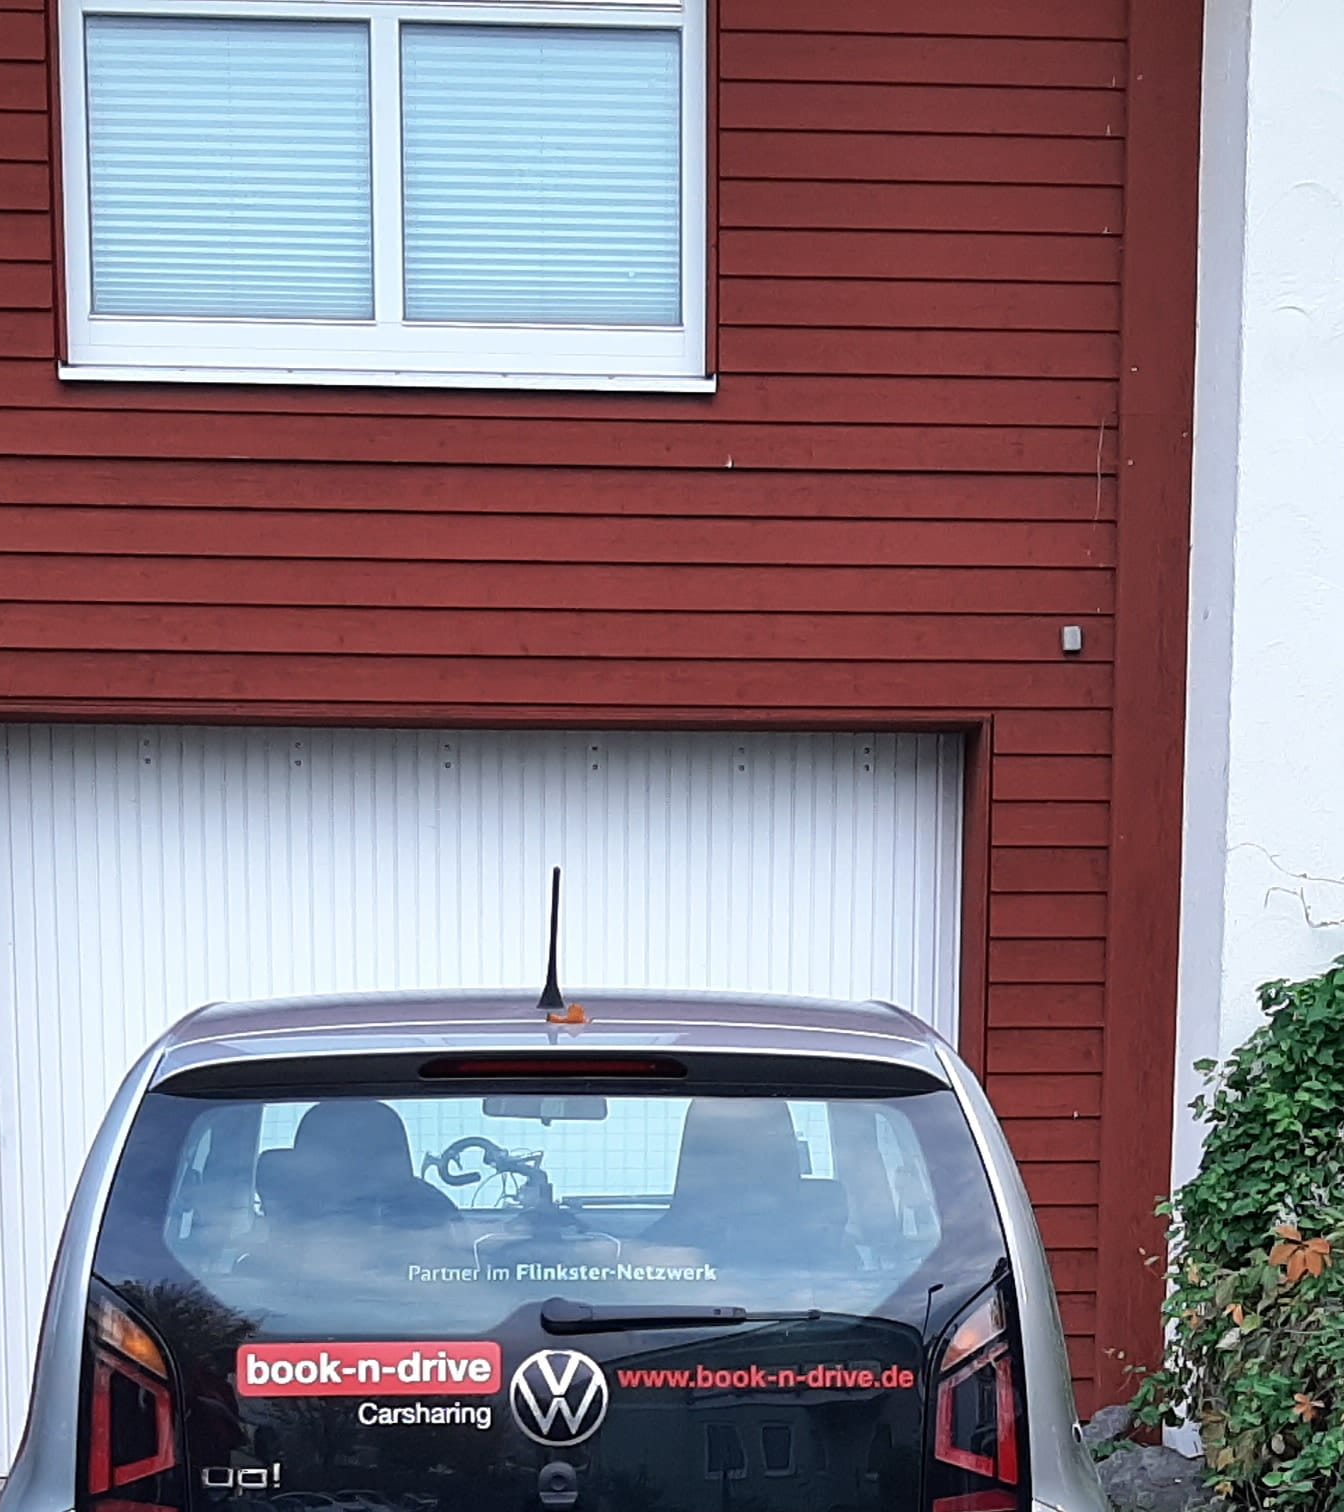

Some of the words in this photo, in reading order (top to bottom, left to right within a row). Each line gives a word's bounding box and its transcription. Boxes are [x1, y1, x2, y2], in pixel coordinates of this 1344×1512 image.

[408, 1265, 480, 1281] Partner
[487, 1265, 509, 1280] im
[516, 1264, 718, 1281] Flinkster-Netzwerk
[246, 1352, 492, 1385] book-n-drive
[617, 1364, 915, 1389] www.book-n-drive.de
[358, 1402, 492, 1429] Carsharing
